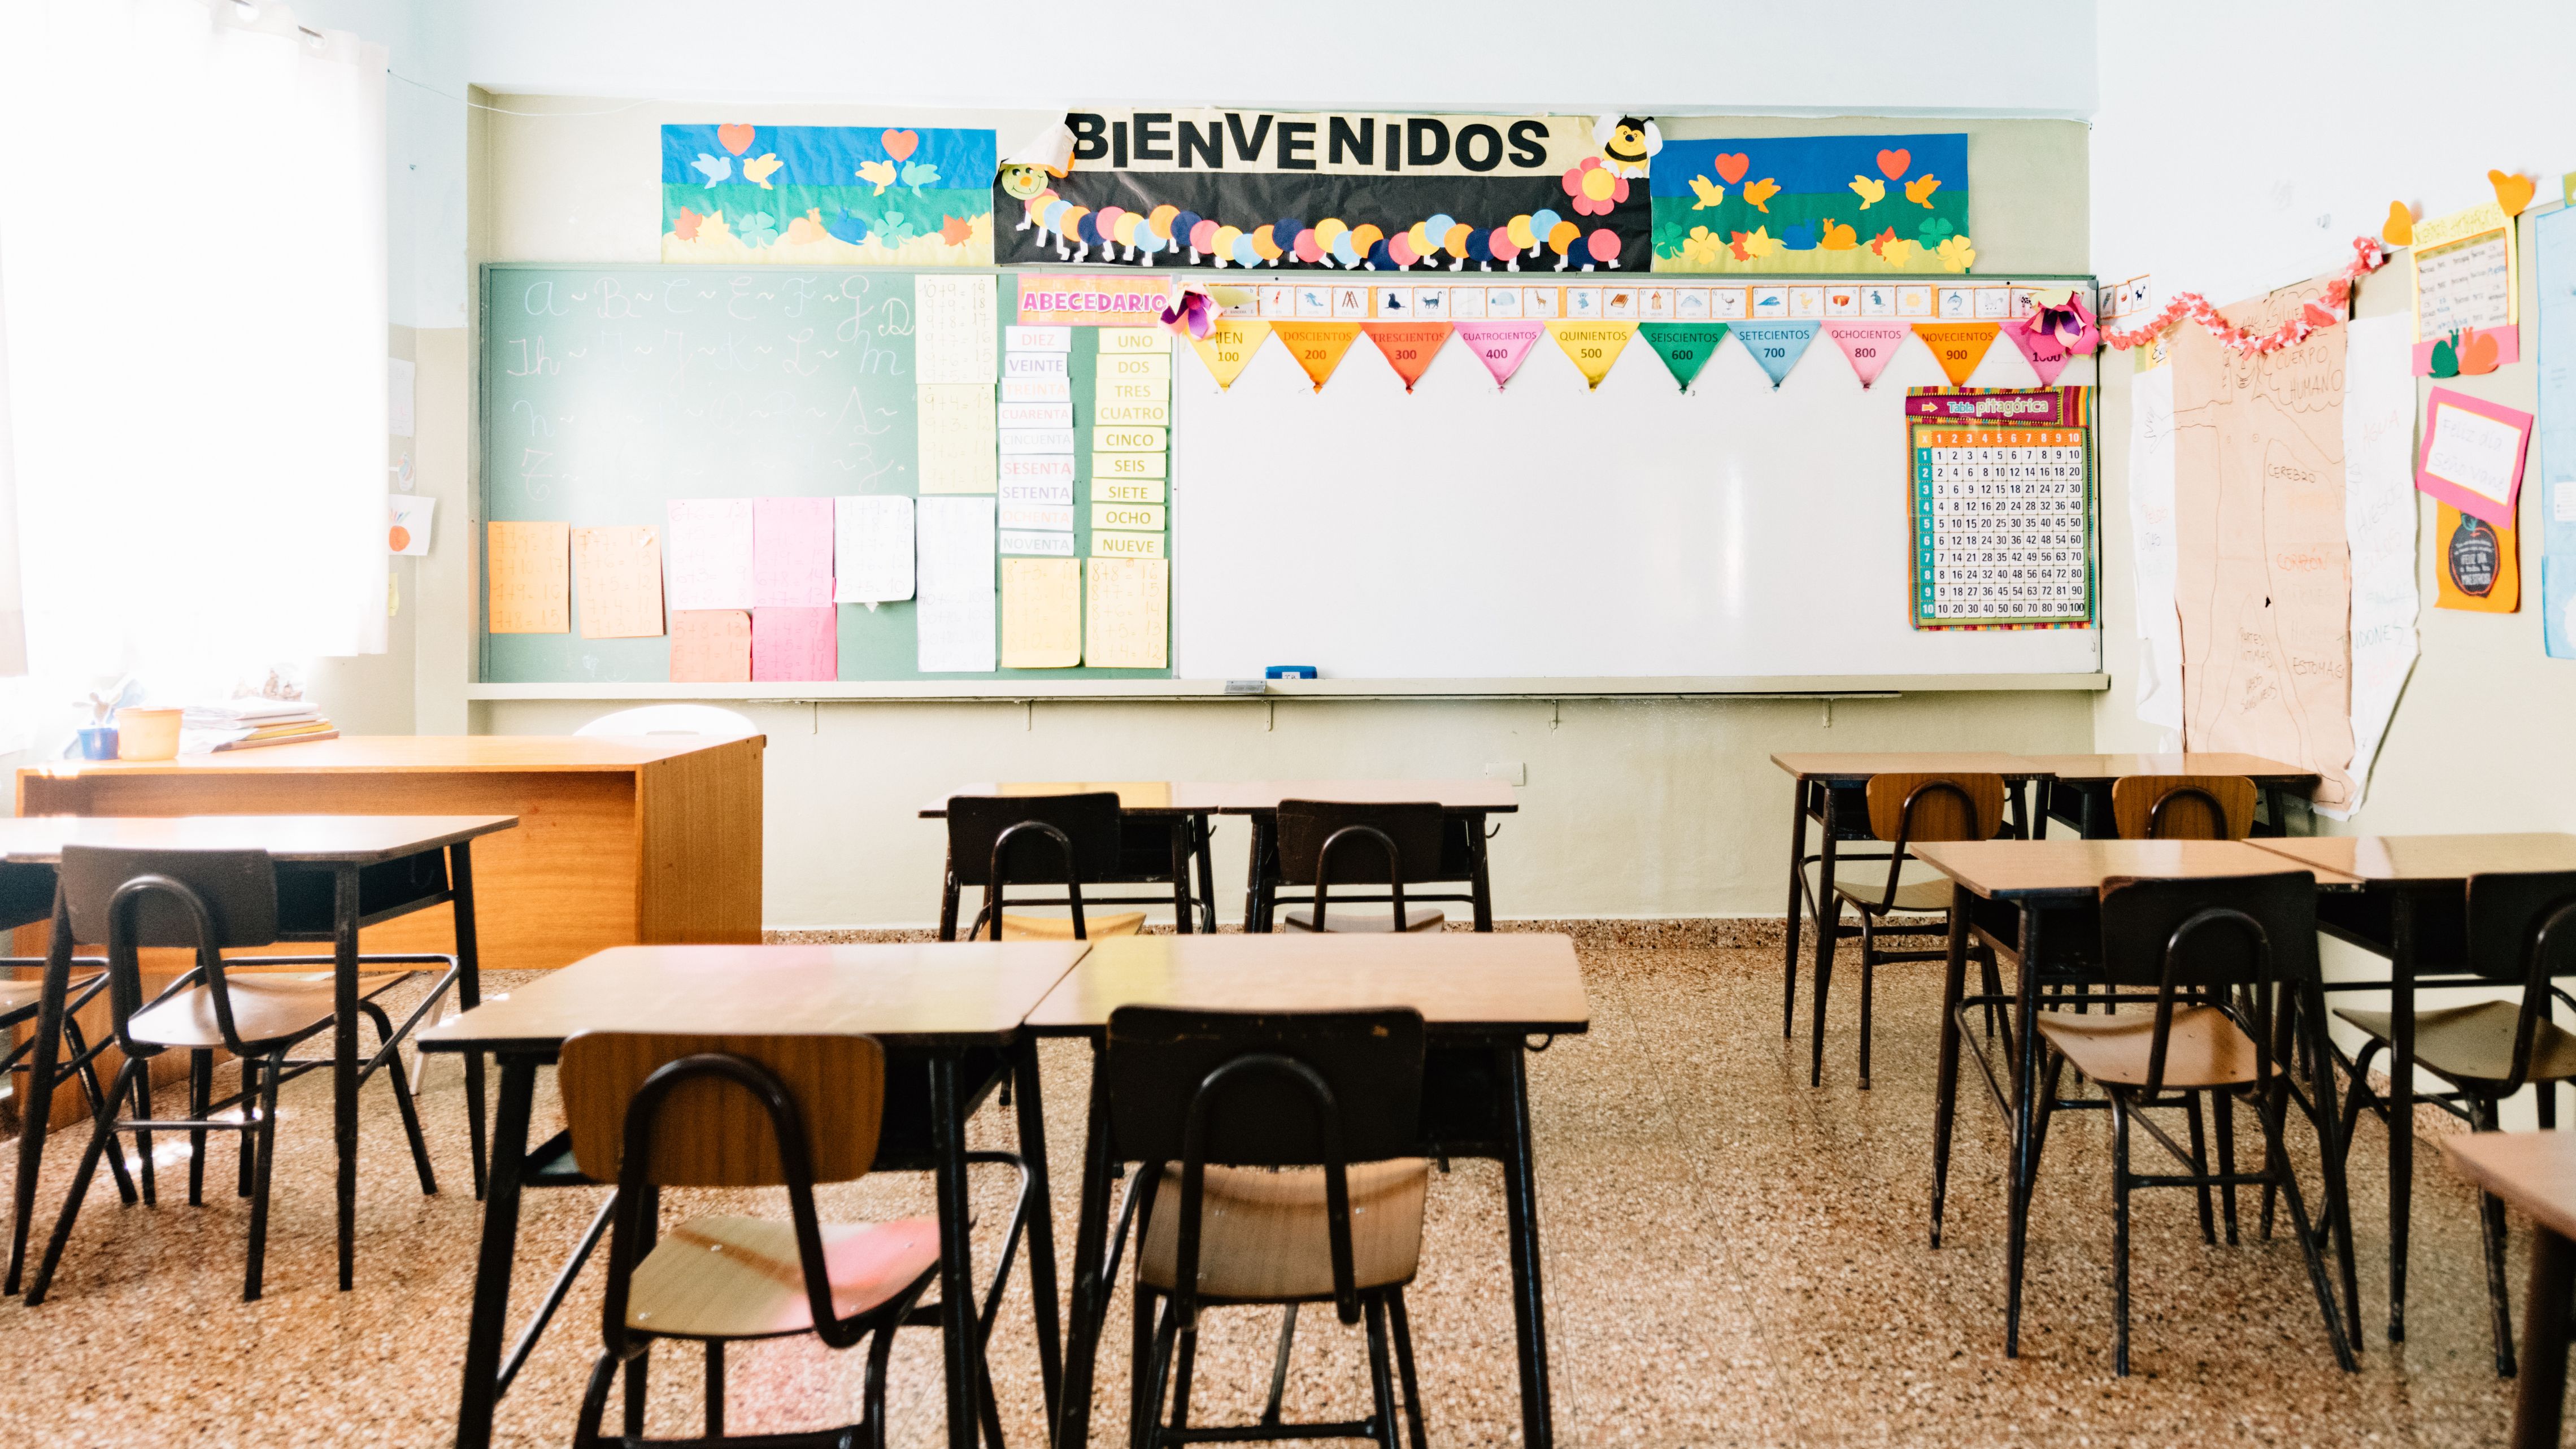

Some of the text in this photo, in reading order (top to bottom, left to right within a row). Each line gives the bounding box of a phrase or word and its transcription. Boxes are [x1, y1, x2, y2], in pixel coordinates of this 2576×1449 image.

[1064, 112, 1550, 172] BIENVENIDOS
[1023, 292, 1168, 312] ABECEDARIO
[1021, 333, 1055, 346] DIEZ
[1216, 332, 1243, 344] IEN
[1283, 331, 1352, 342] DOSCIENTOS
[1371, 332, 1445, 342] TRESCIENTOS
[1463, 331, 1537, 342] CUATROCIENTOS
[1559, 331, 1628, 342] QUINIENTOS
[1651, 332, 1718, 343] SEISCIENTOS
[1739, 329, 1810, 341] SETECIENTOS
[1831, 329, 1902, 340] OCHOCIENTOS
[1921, 331, 1994, 343] NOVECIENTOS
[1118, 335, 1153, 348] UNO
[1218, 351, 1239, 362] 100
[1304, 349, 1327, 360] 200
[1395, 349, 1417, 360] 300
[1486, 348, 1508, 359] 400
[1580, 348, 1603, 358] 500
[1672, 349, 1694, 360] 600
[1764, 347, 1786, 358] 700
[1855, 347, 1877, 359] 800
[1946, 349, 1968, 360] 900
[2276, 346, 2328, 370] CUERPO
[1009, 359, 1064, 372] VEINTE
[1118, 360, 1150, 373] DOS
[2290, 360, 2344, 401] HUMANO
[1005, 383, 1066, 396] TREINTA
[1114, 385, 1151, 398] TRES
[1100, 407, 1164, 420] CUATRO
[1947, 398, 2049, 417] Tabla pitagórica
[1002, 408, 1069, 420] CUARENTA
[1003, 433, 1072, 446] CINCUENTA
[1106, 433, 1154, 447] CINCO
[1937, 433, 2079, 443] 1 2 3 4 5 6 7 8 9 10
[1922, 450, 2079, 460] 1 1 2 3 4 5 6 7 8 9 10
[1003, 462, 1072, 476] SESENTA
[1114, 459, 1145, 473] SEIS
[1922, 467, 2080, 477] 2 2 4 6 8 10 12 14 16 18 20
[1002, 486, 1071, 500] SETENTA
[1108, 486, 1148, 499] SIETE
[1923, 484, 2081, 494] 3 3 6 9 12 15 18 21 24 27 30
[1924, 501, 2081, 511] 4 4 8 12 16 20 24 28 32 36 40
[1002, 511, 1071, 524] OCHENTA
[1106, 511, 1151, 525] OCHO
[1924, 518, 2081, 529] 5 5 10 15 20 25 30 35 40 45 50
[1003, 537, 1070, 551] NOVENTA
[1102, 539, 1155, 554] NUEVE
[2293, 657, 2344, 678] ESTOMAG
